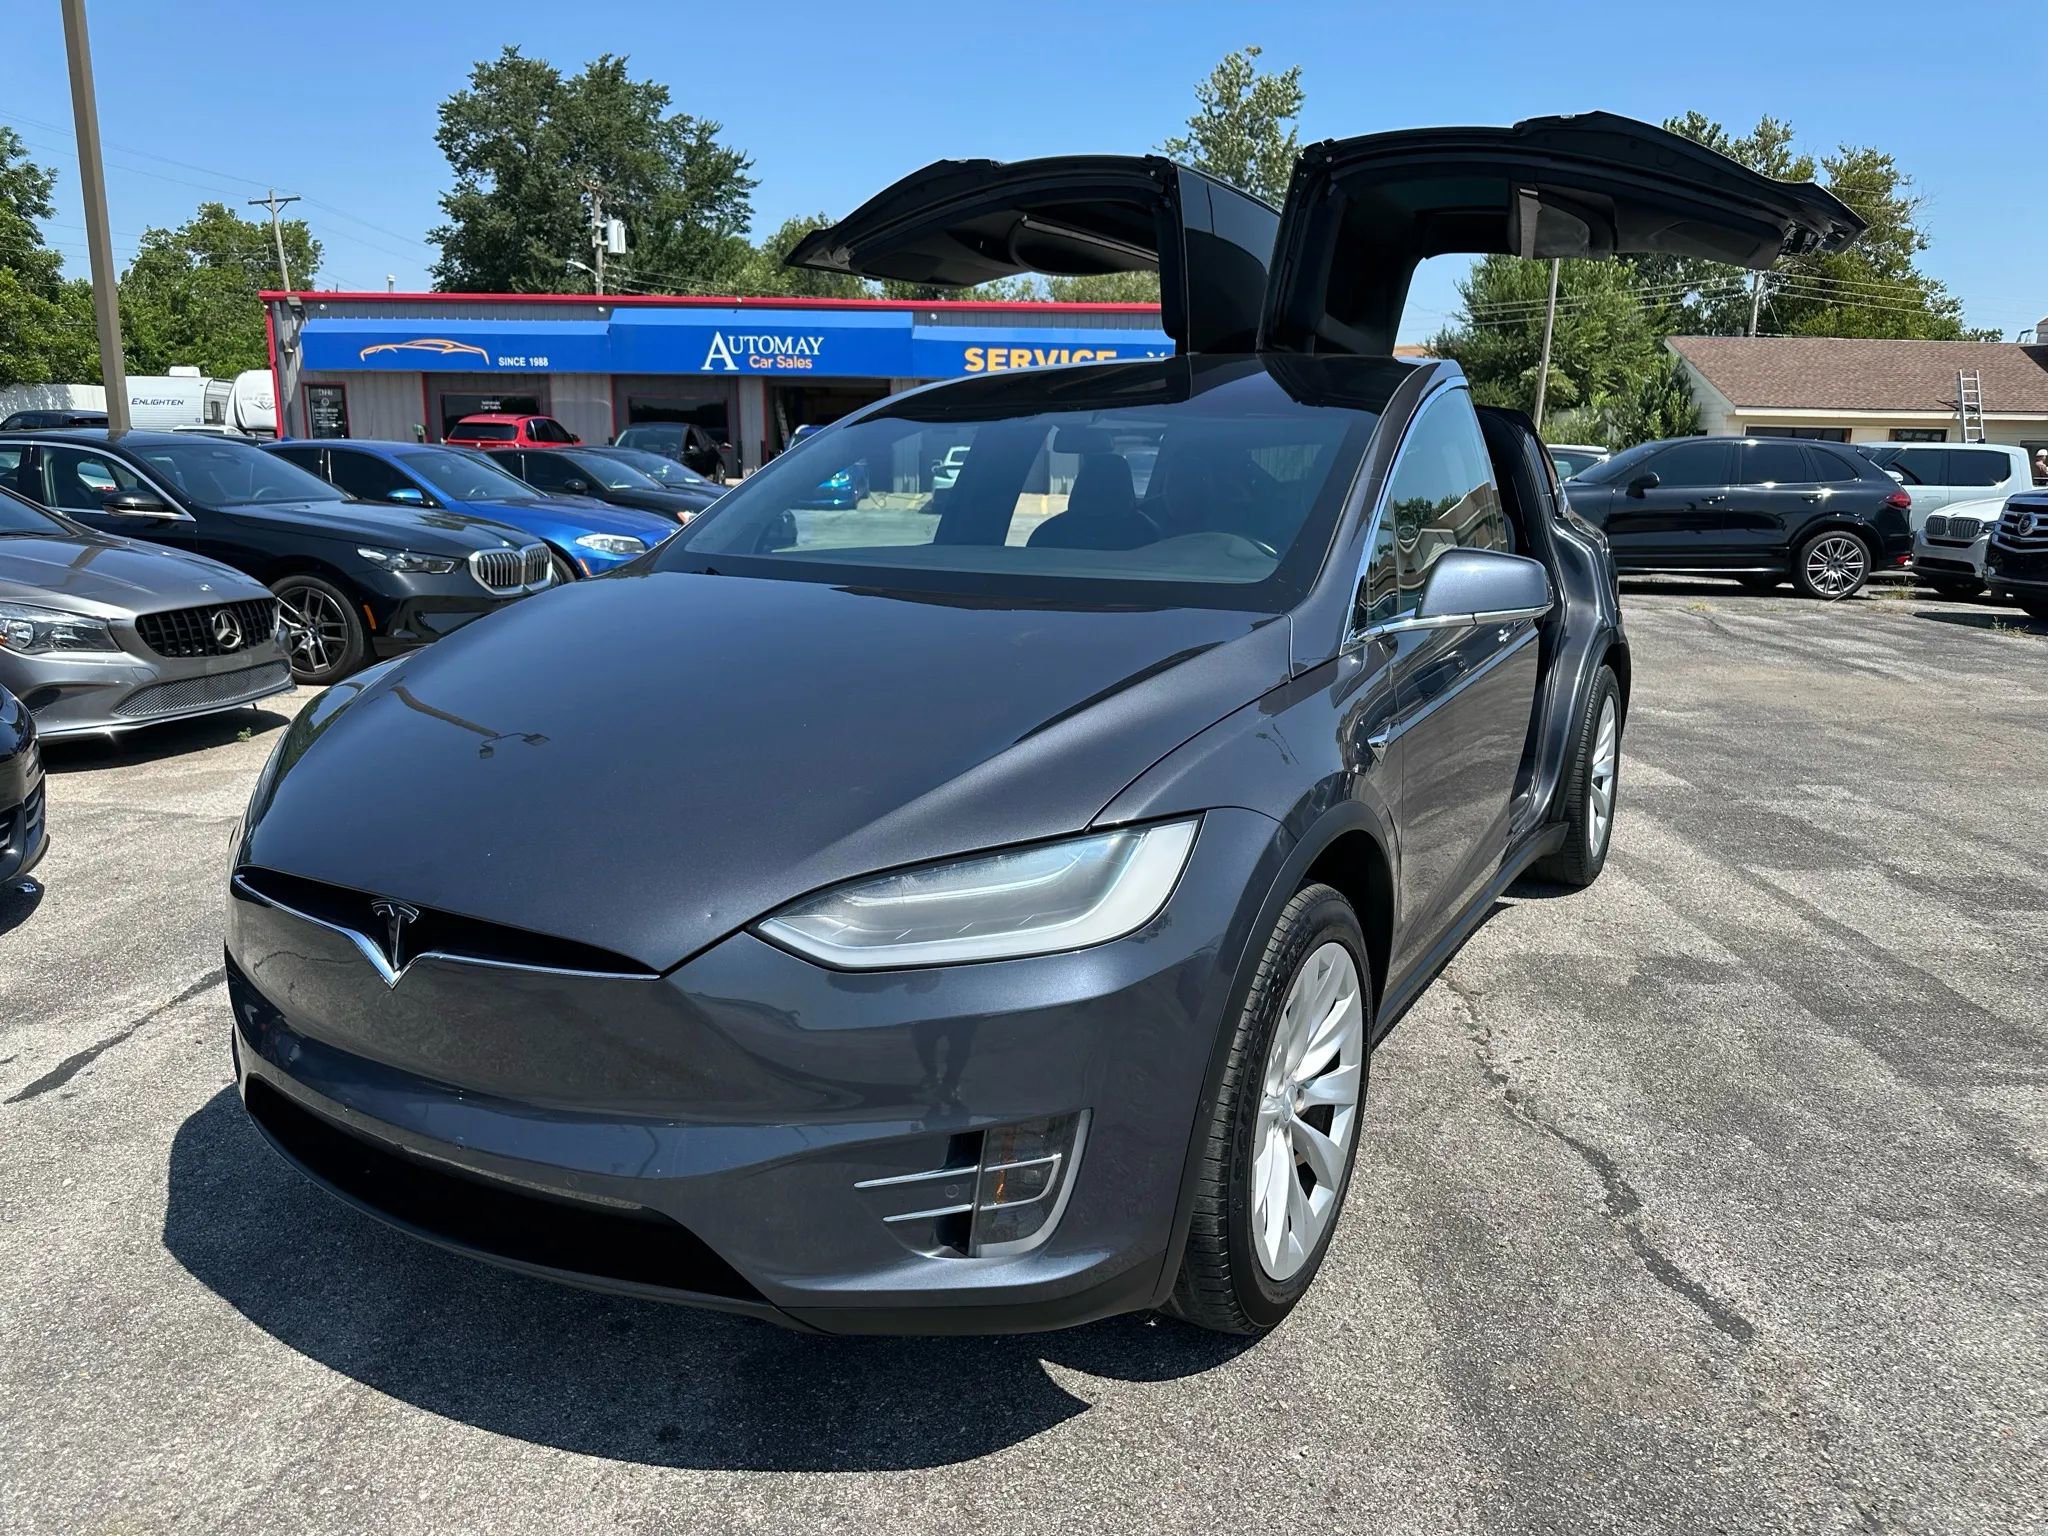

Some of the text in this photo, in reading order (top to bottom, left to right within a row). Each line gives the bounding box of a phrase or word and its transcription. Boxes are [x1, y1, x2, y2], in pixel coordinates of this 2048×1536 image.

[701, 330, 825, 371] AUTOMAY
[498, 356, 549, 367] SINCE 1988
[749, 355, 813, 369] Car Sales
[131, 397, 184, 406] ENLIGHTEN
